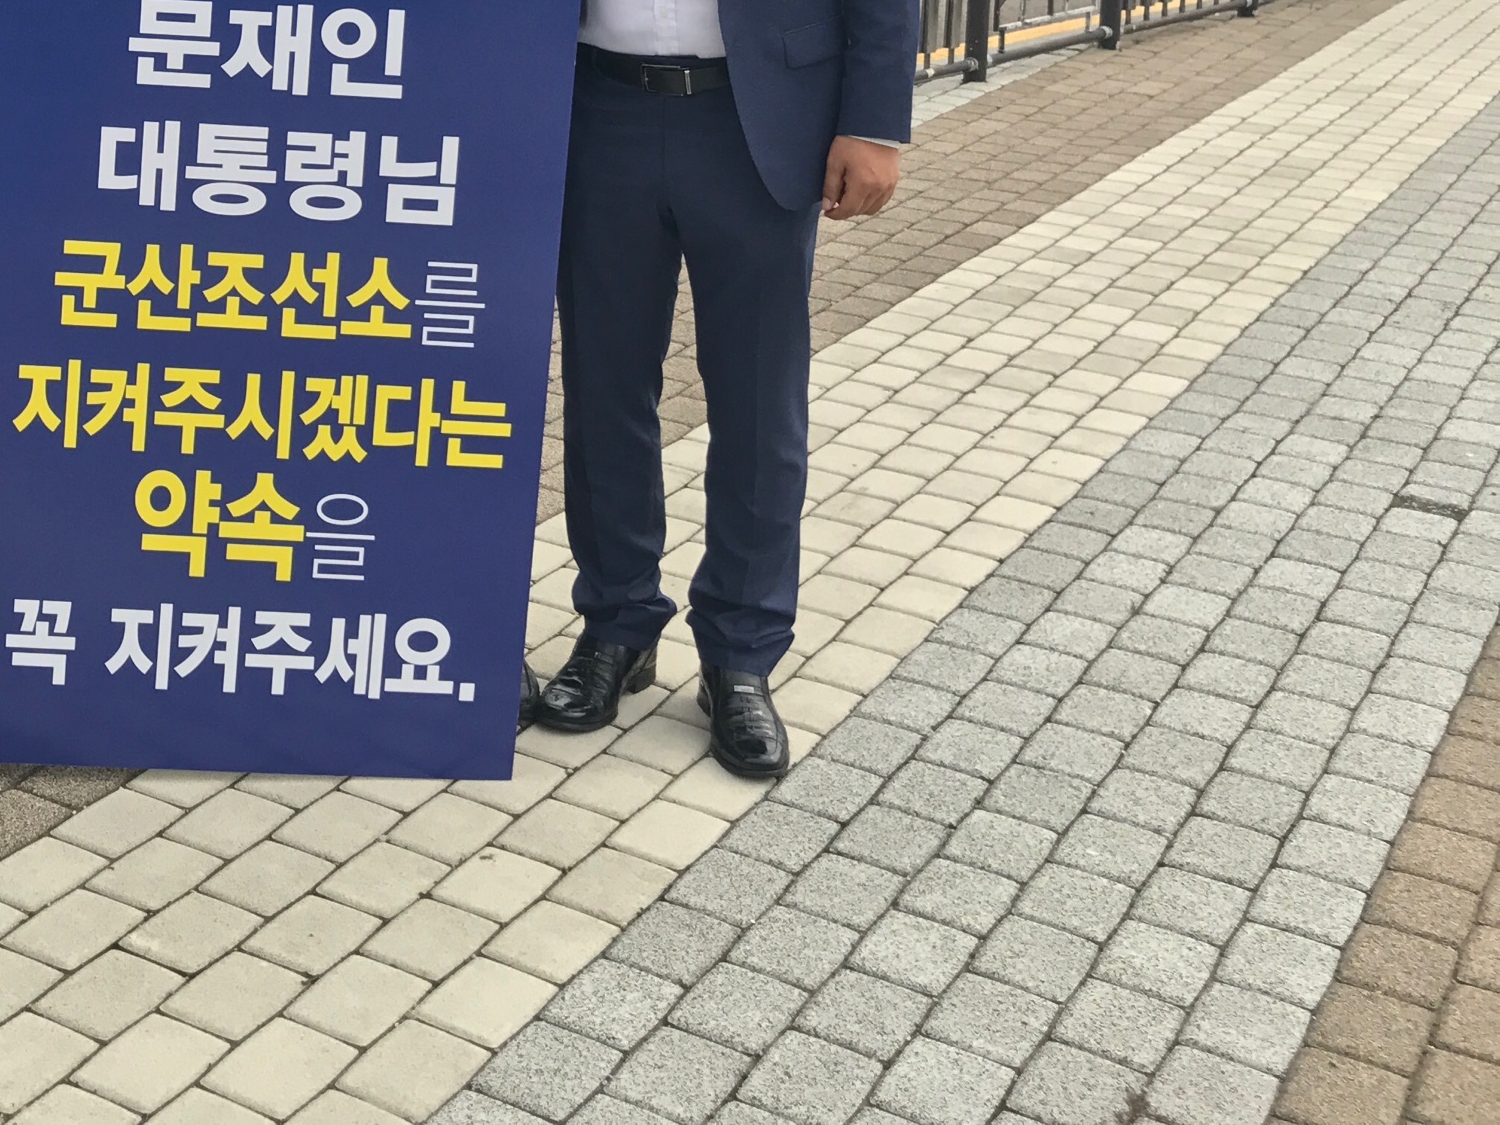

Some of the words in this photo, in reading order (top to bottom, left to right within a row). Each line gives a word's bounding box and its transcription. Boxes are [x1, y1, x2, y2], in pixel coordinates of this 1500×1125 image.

[97, 120, 460, 227] 대통령님
[54, 239, 486, 349] 군산조선소를
[12, 358, 513, 469] 지켜주시겠다는
[134, 469, 376, 582] 약속을
[5, 598, 77, 686] 꼭
[104, 602, 476, 702] 지켜주세요.
